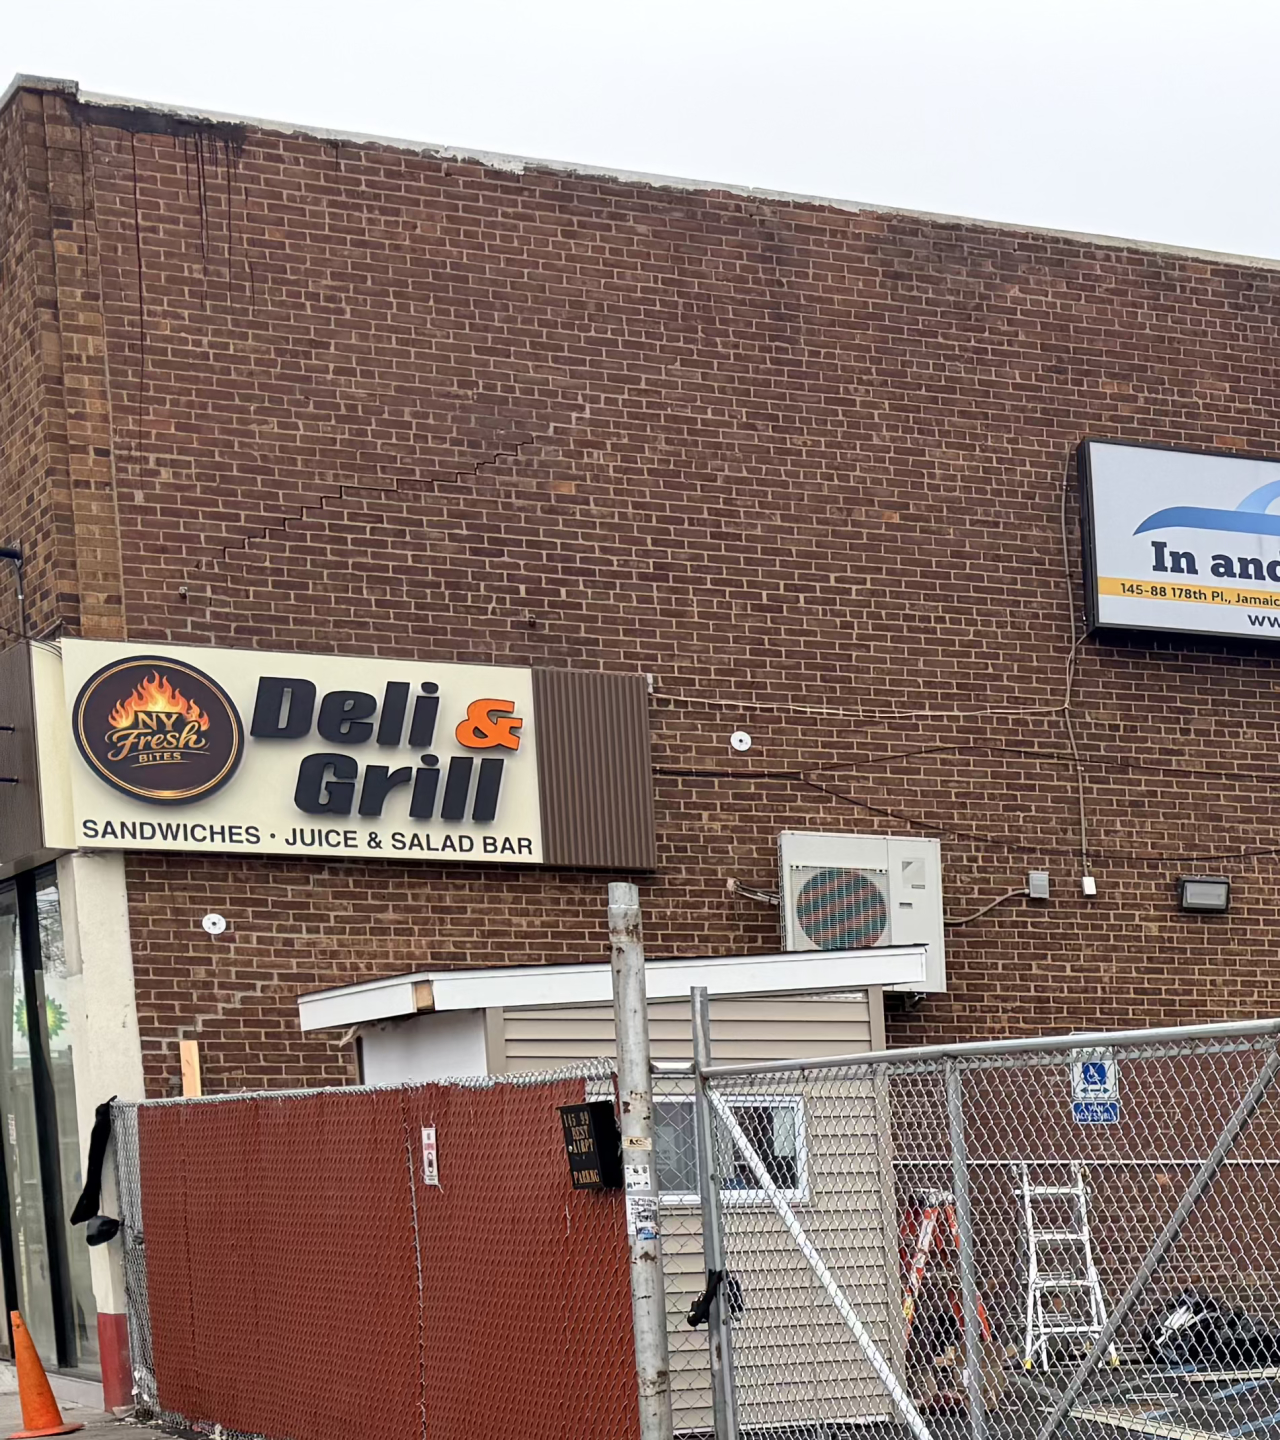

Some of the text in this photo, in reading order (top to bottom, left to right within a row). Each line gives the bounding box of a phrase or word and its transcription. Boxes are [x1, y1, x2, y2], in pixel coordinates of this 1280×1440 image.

[1151, 541, 1198, 575] In
[1121, 583, 1167, 597] 145-88
[1171, 587, 1207, 601] 178th
[137, 712, 179, 731] NY
[250, 676, 523, 751] Deli &
[105, 722, 210, 761] Fresh
[139, 752, 182, 763] BITES
[294, 753, 504, 821] Grill
[82, 819, 533, 856] SANDWICHES JUICE & SALAD BAR
